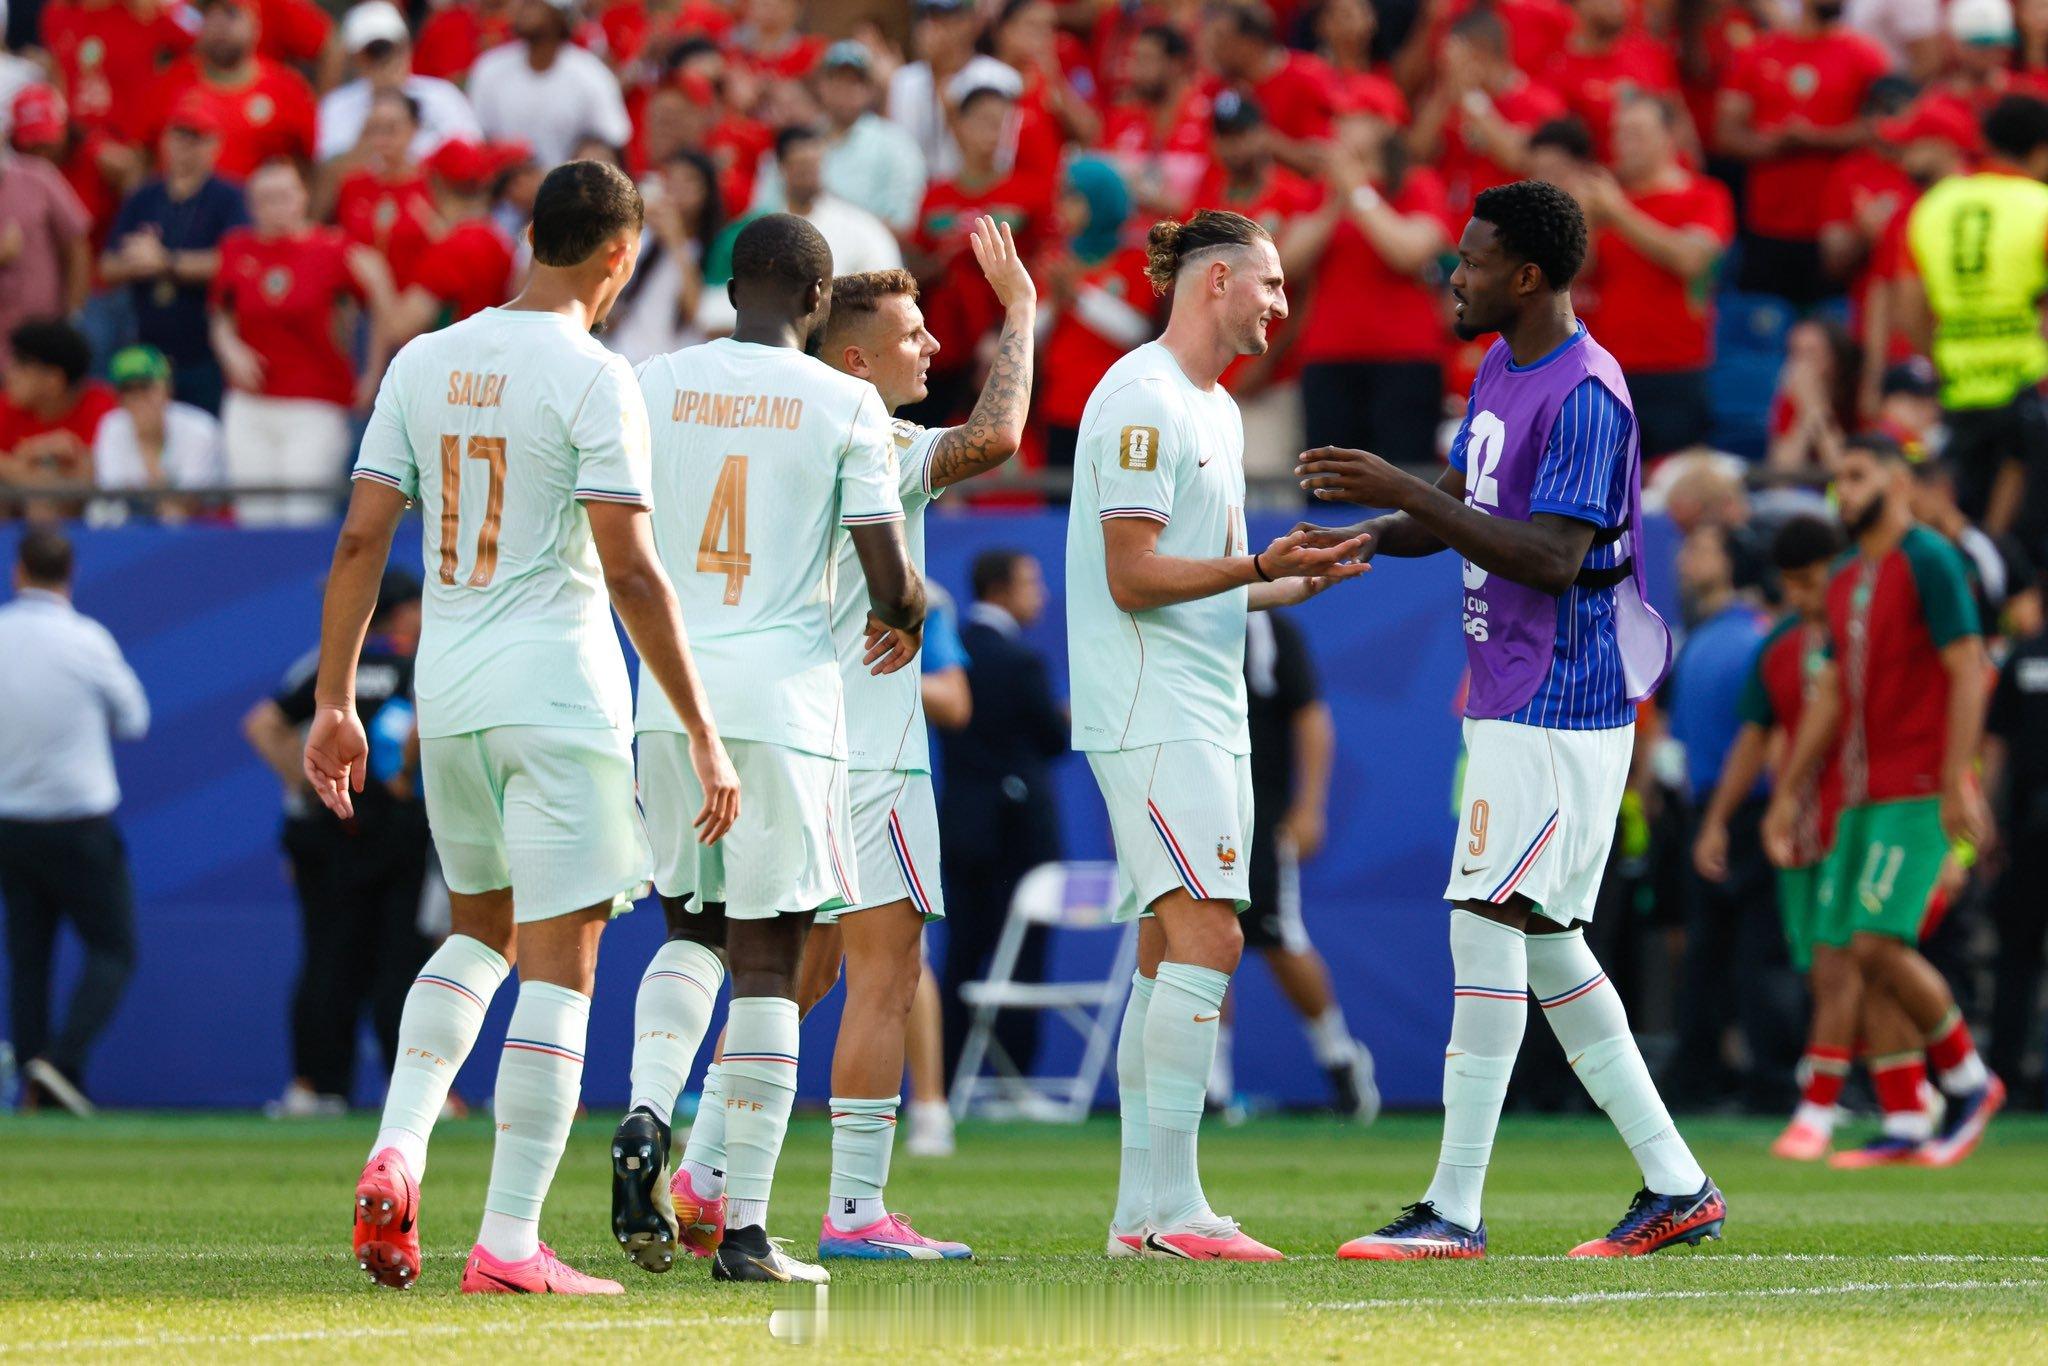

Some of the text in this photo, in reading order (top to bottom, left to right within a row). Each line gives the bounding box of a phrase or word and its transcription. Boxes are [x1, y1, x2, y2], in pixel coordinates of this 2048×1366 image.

[672, 389, 803, 430] UPAMECANO
[439, 434, 507, 588] 17
[696, 454, 751, 605] 4
[1467, 596, 1489, 615] CUP
[1469, 799, 1489, 856] 9
[407, 1048, 446, 1066] FFF
[727, 1099, 764, 1111] FFF
